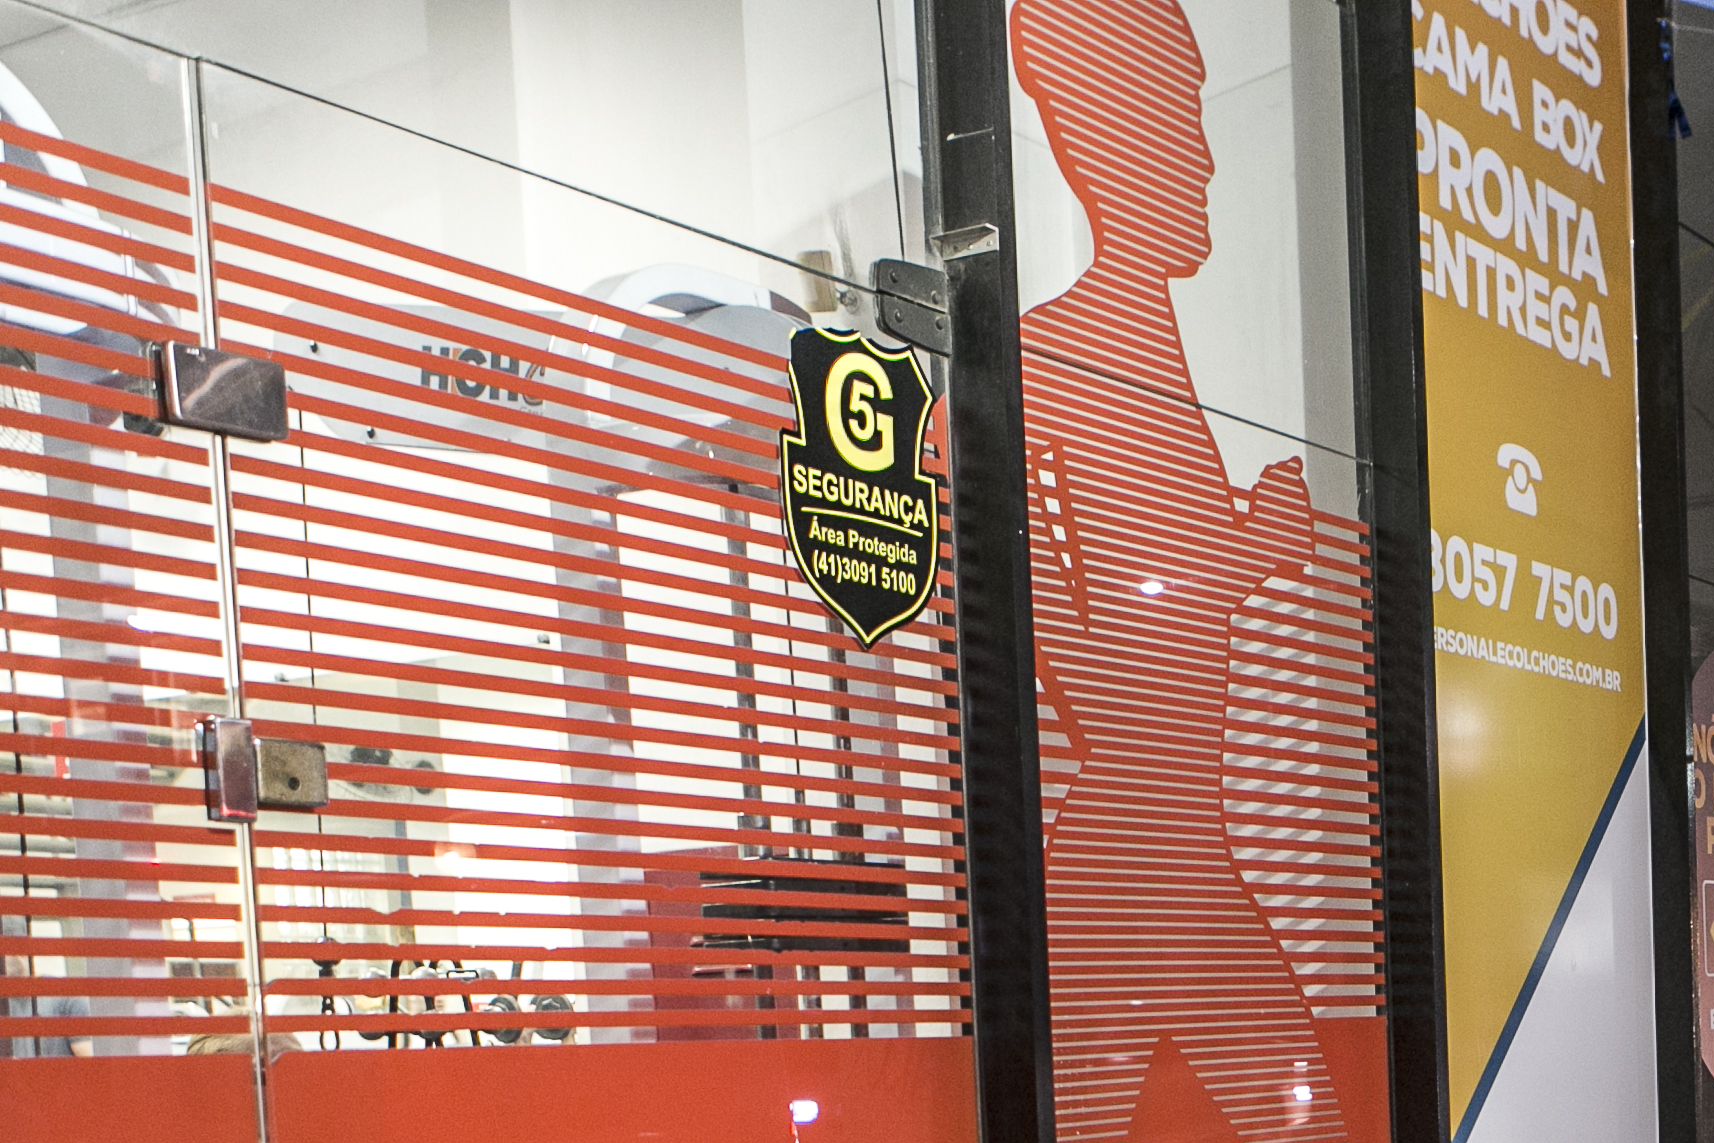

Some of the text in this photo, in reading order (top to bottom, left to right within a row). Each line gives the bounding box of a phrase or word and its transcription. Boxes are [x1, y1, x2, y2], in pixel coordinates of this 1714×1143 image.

[1532, 78, 1605, 184] BOX
[793, 463, 929, 528] SEGURANÇA
[809, 515, 917, 565] Área Protegida
[812, 549, 917, 596] (41)3091 5100
[1531, 560, 1619, 641] 7500
[1693, 767, 1706, 809] O
